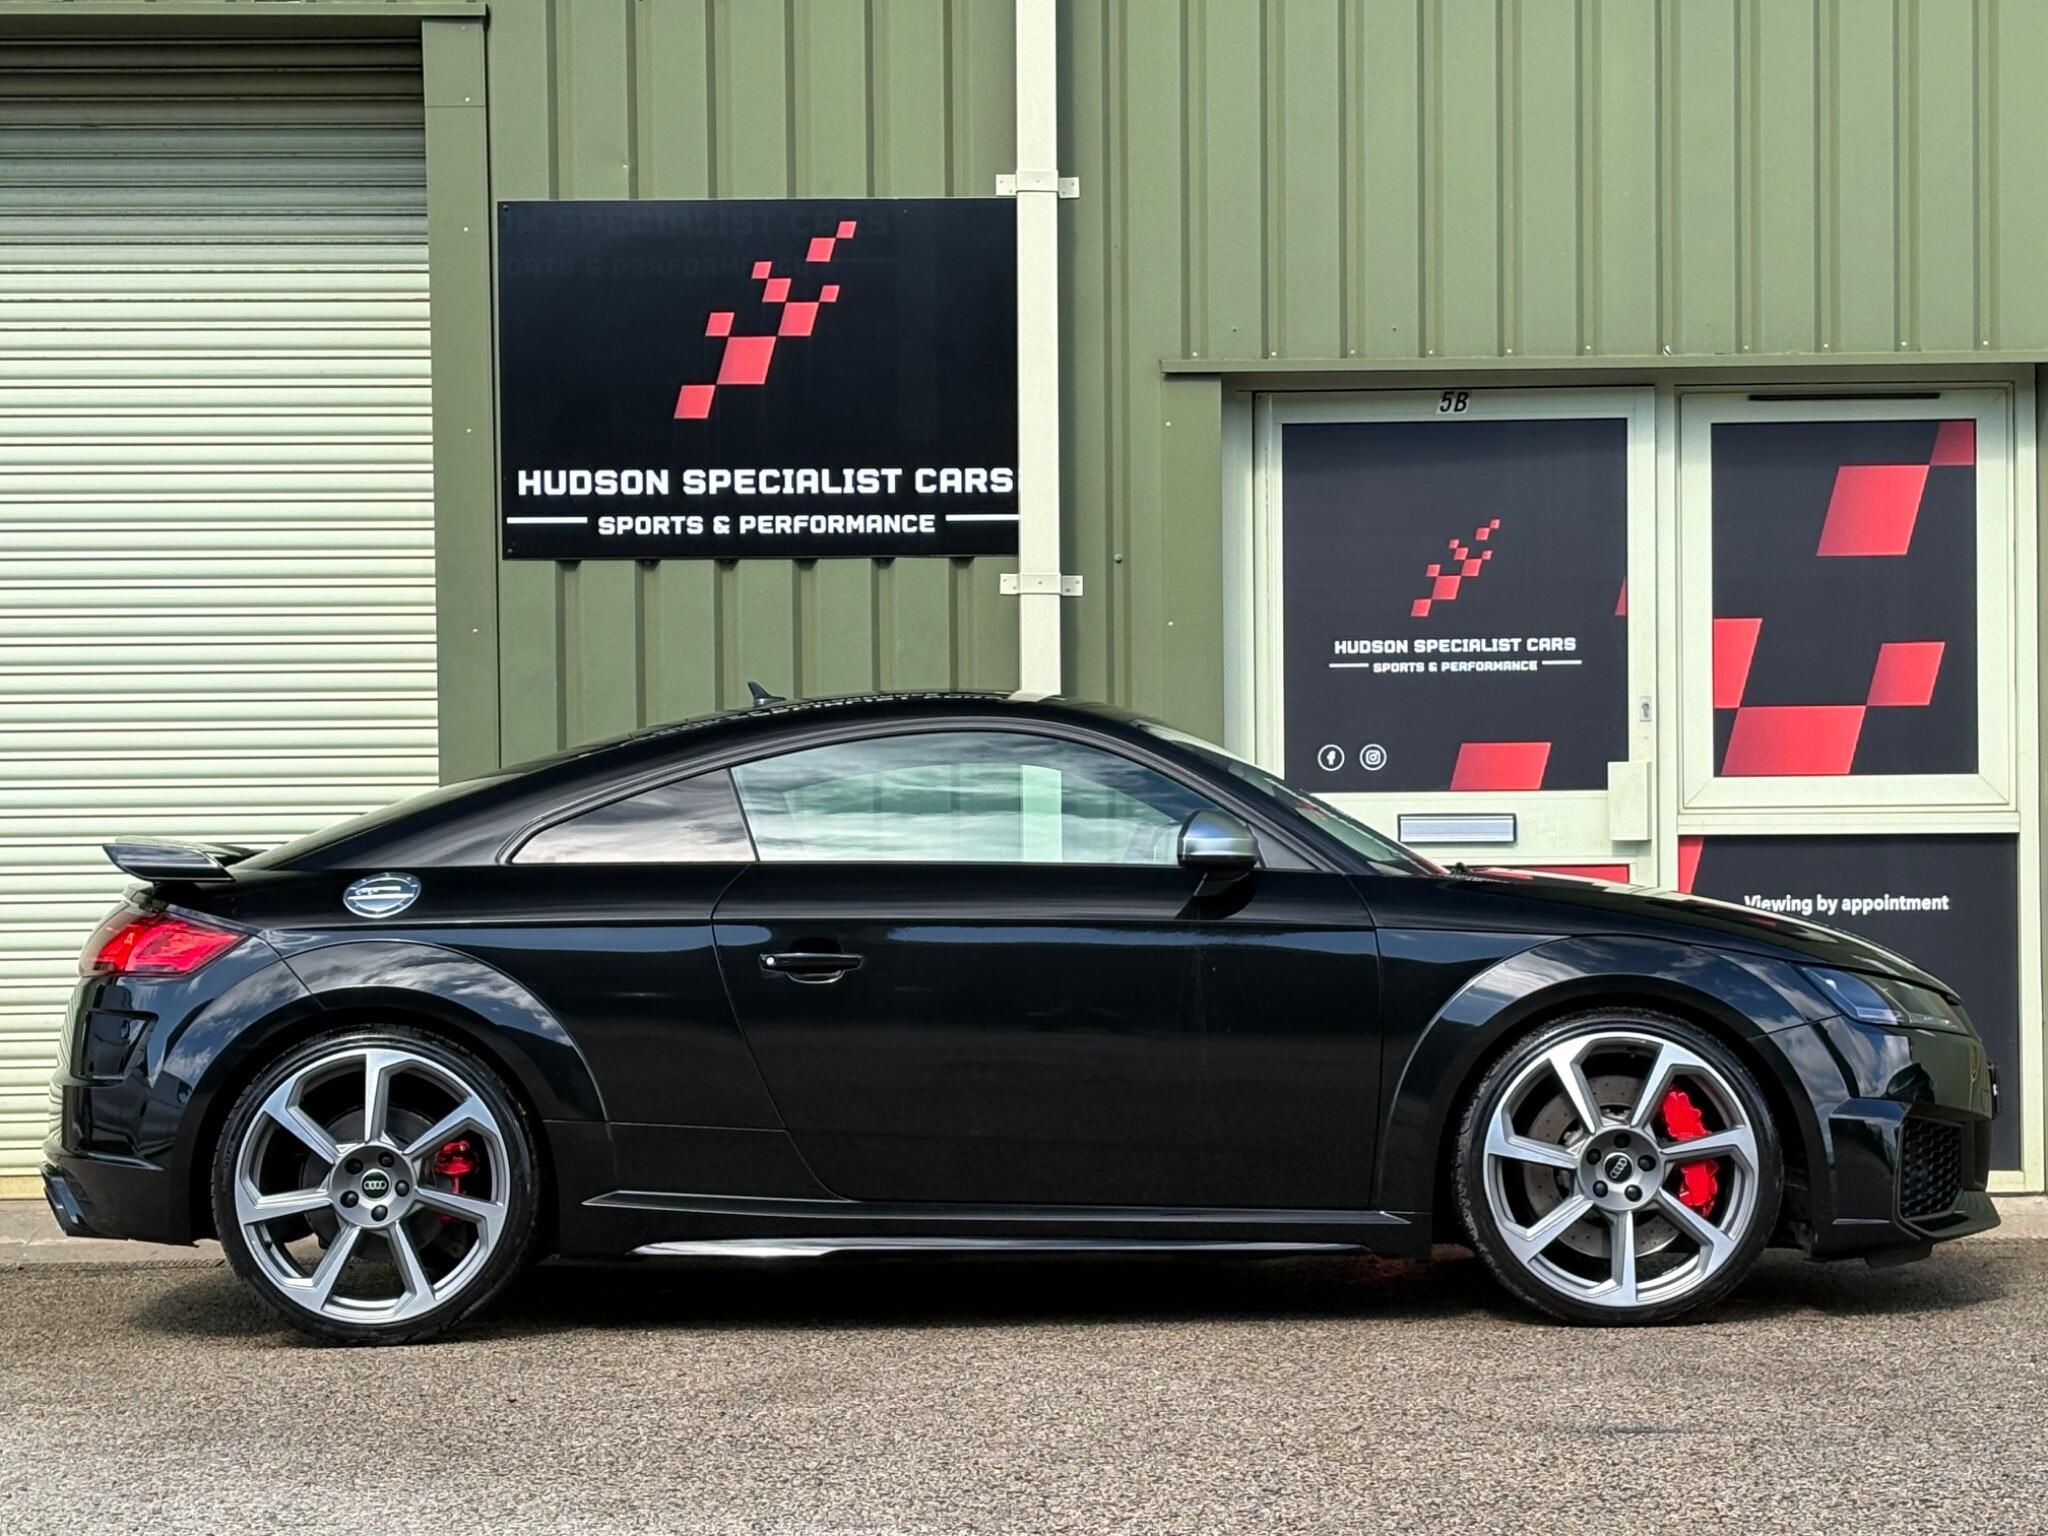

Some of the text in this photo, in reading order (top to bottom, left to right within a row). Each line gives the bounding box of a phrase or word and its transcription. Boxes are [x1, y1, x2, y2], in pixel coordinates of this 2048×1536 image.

[1440, 391, 1468, 412] 5B
[518, 467, 1014, 496] HUDSON SPECIALIST CARS
[598, 514, 936, 535] SPORTS & PERFORMANCE
[1334, 637, 1577, 654] HUDSON SPECIALIST CARS
[1373, 660, 1538, 673] SPORTS & PERFORMANCE
[1744, 894, 1950, 916] Viewing by appointment
